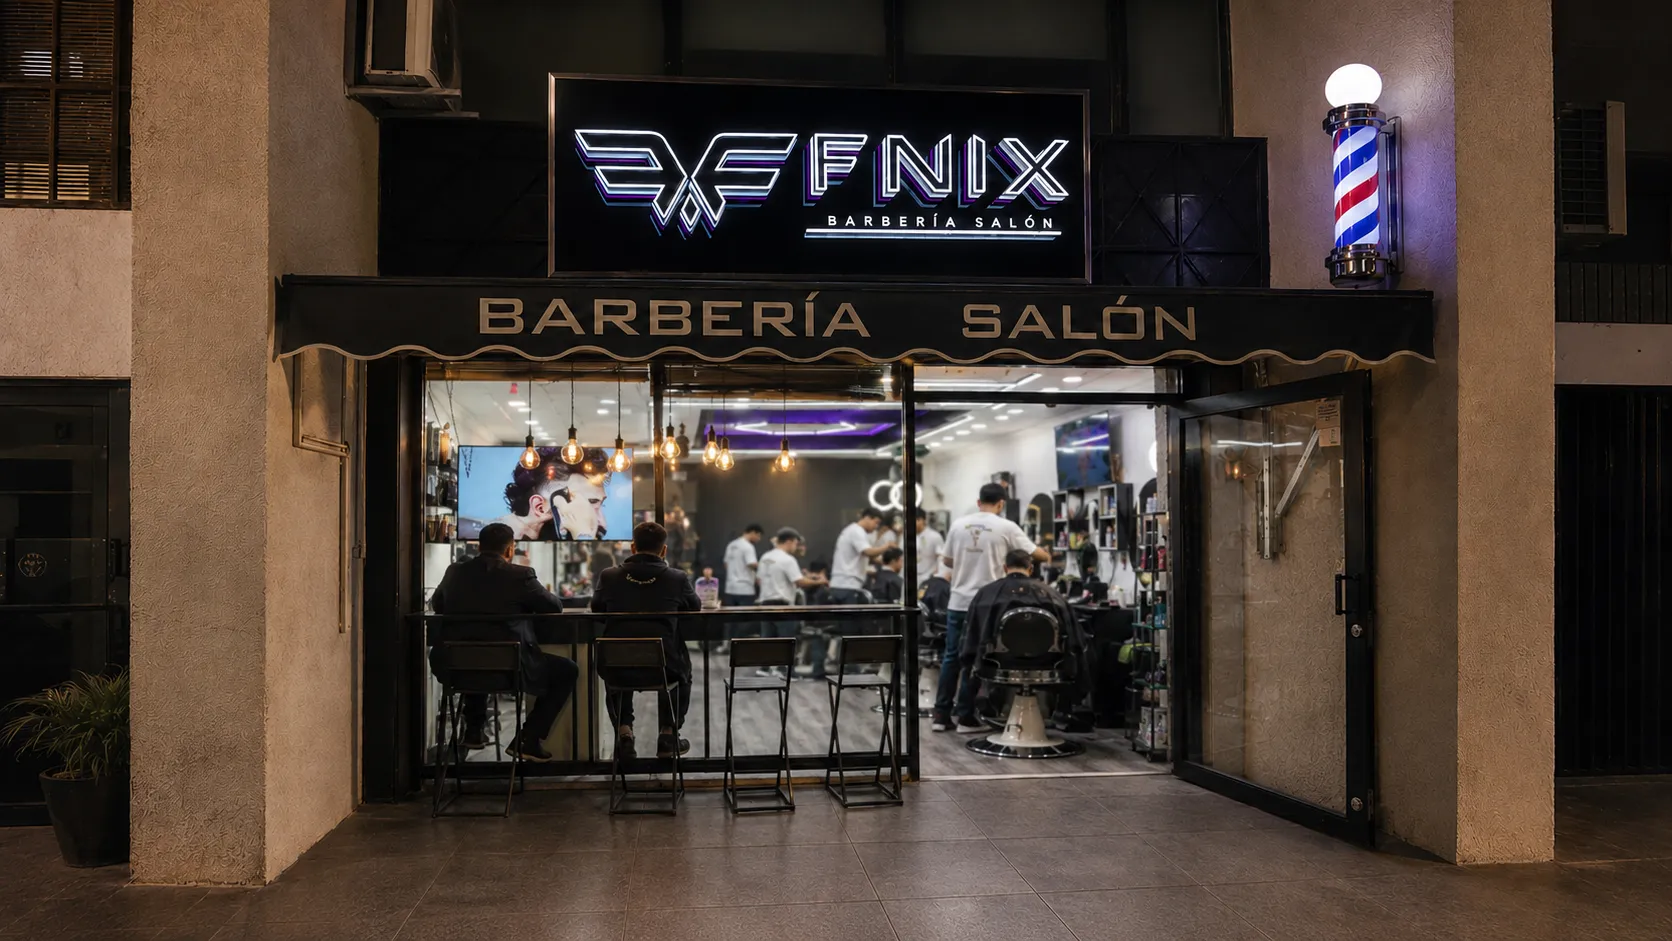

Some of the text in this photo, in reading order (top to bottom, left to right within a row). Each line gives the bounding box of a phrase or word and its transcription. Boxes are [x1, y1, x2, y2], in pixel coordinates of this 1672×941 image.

[804, 133, 1069, 208] FNIX
[827, 213, 1053, 229] BARBERÍA SALÓN
[479, 291, 1197, 341] BARBERÍA SALÓN
